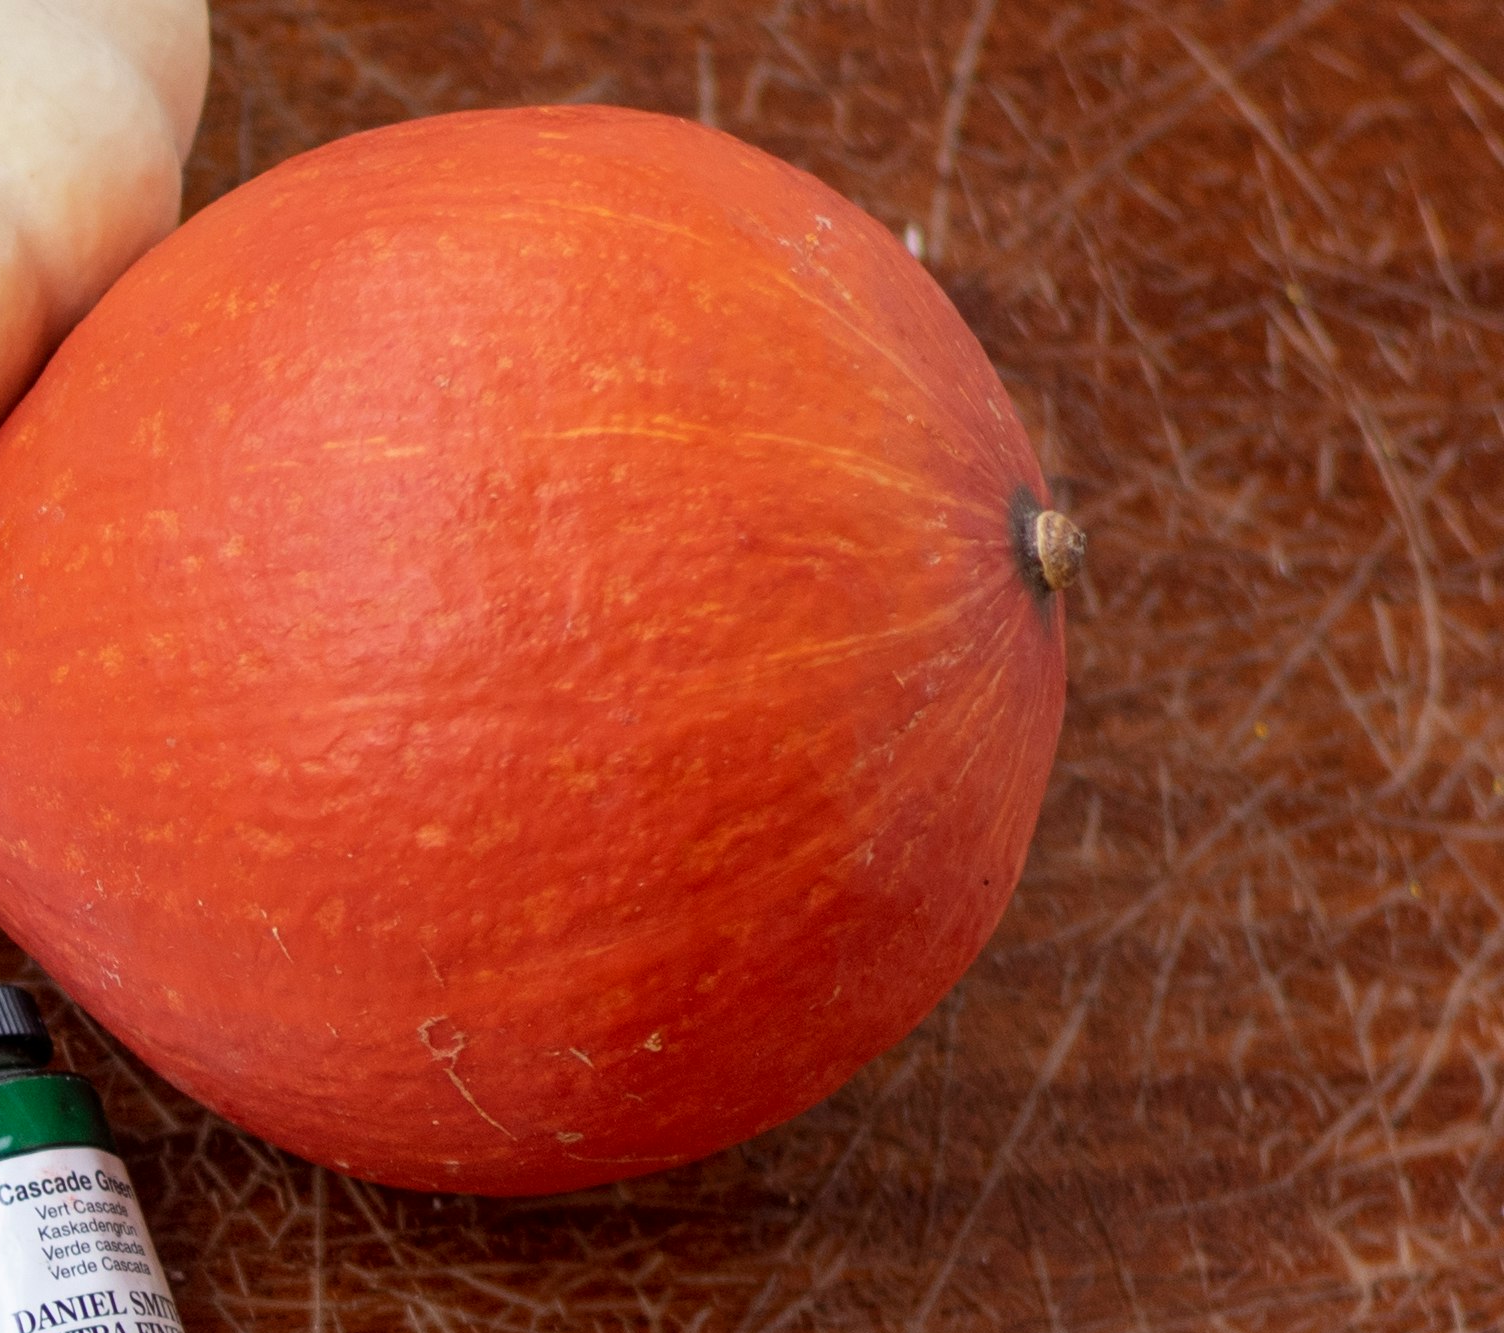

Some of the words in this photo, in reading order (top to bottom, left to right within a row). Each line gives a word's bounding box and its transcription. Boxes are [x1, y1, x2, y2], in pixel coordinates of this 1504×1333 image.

[95, 1170, 134, 1198] Green
[34, 1203, 71, 1220] Vert
[73, 1199, 129, 1217] Cascade
[38, 1219, 138, 1241] Kaskadengrün
[42, 1241, 91, 1260] Verde
[95, 1240, 146, 1256] cascada
[50, 1260, 98, 1280] Verde
[101, 1256, 151, 1275] Cascata
